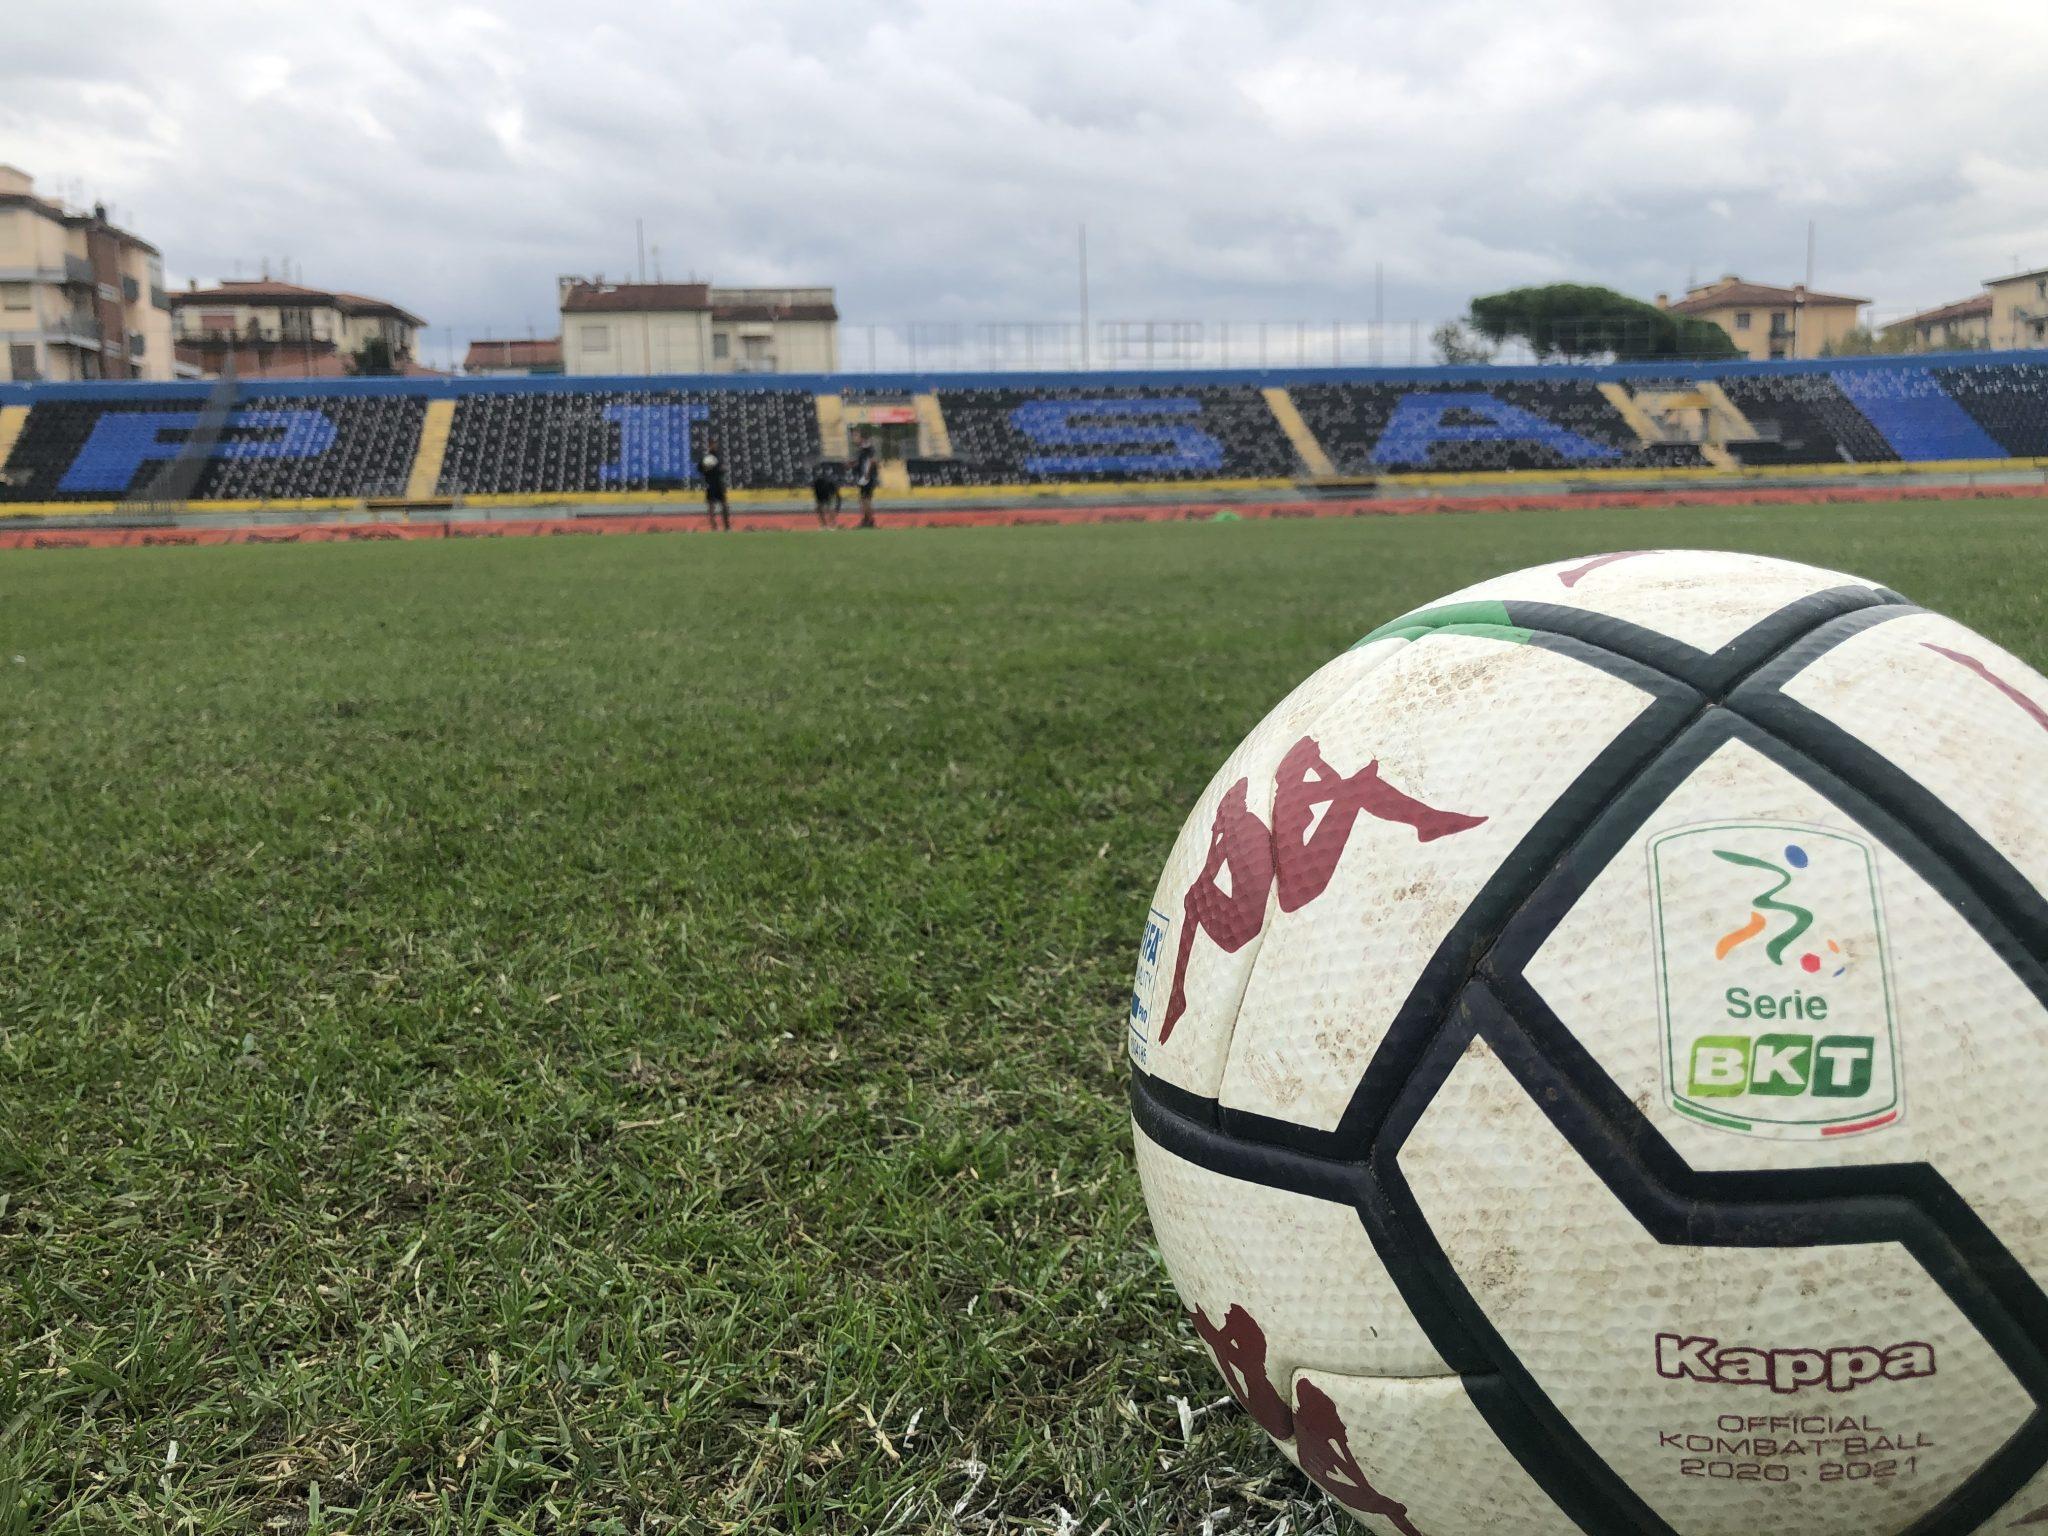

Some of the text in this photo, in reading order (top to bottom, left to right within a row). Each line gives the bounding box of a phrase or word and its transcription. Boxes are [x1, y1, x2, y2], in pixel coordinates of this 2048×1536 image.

[57, 392, 1624, 492] PISA
[1725, 986, 1828, 1021] Serie
[1691, 1041, 1872, 1090] BKT
[1655, 1332, 1936, 1393] Kappa
[1717, 1414, 1884, 1434] OFFICIAL
[1844, 1431, 1935, 1456] BALL
[1680, 1455, 1916, 1482] 2020 2021
